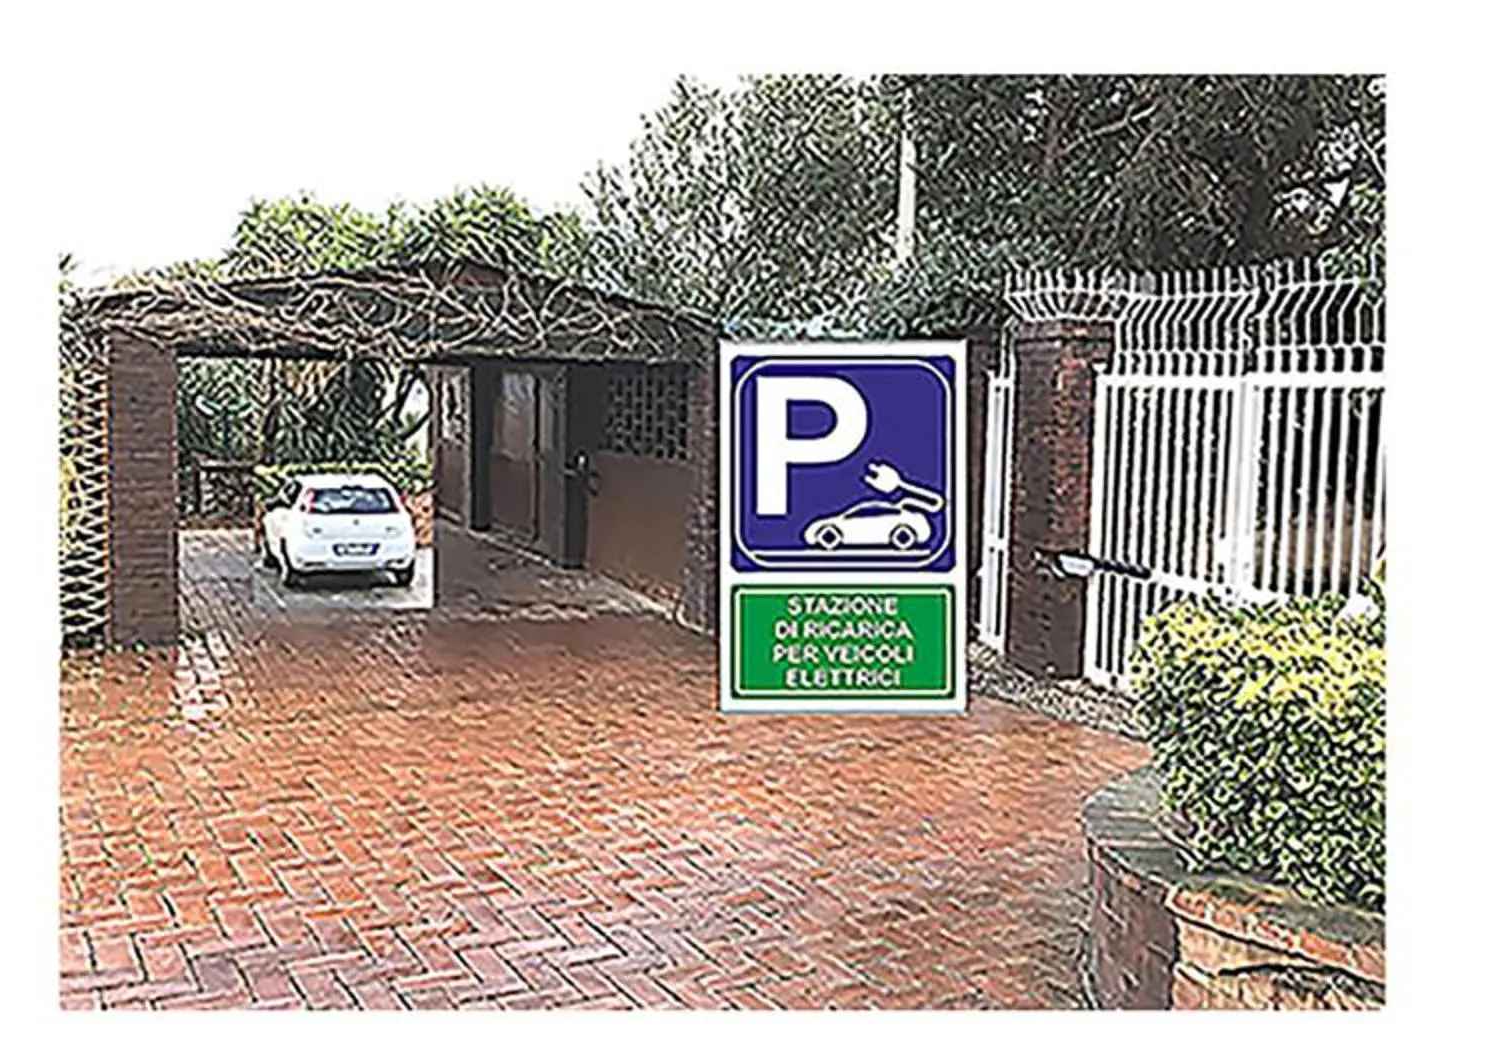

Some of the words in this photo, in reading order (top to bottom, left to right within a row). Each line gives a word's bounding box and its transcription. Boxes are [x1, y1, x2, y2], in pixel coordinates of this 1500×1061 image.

[756, 376, 868, 517] P
[786, 596, 900, 616] STAZIONE
[774, 620, 798, 640] DI
[803, 620, 913, 640] RICARICA
[772, 644, 819, 664] PER
[823, 644, 914, 664] VEICOLI
[785, 667, 900, 687] ELETTRICI
